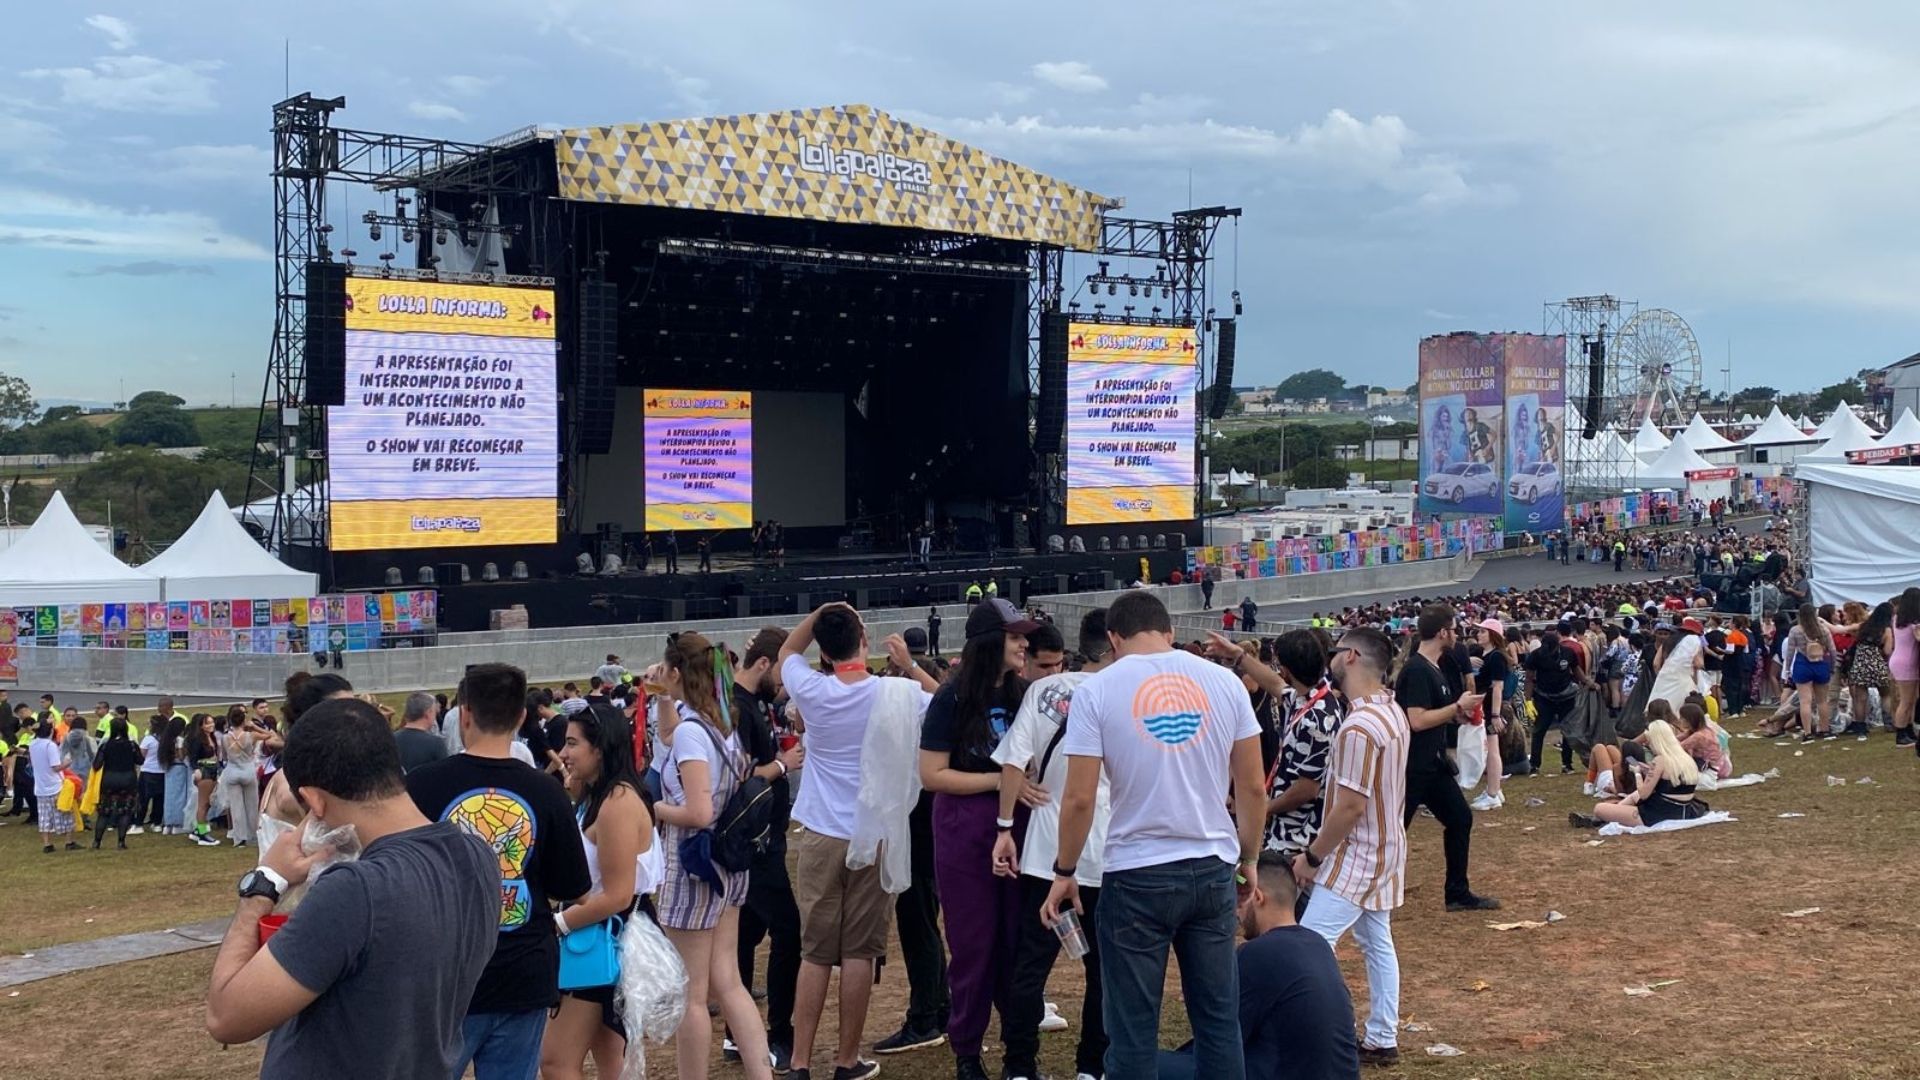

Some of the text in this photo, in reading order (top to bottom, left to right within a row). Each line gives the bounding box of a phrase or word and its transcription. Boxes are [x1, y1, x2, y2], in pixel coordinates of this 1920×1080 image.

[378, 295, 508, 318] LOLLA INFORMA:
[1096, 335, 1124, 347] LOLLA
[375, 355, 512, 373] A APRESENTAÇÃO FOI
[359, 373, 523, 391] INTERROMPIDA DEVIDO A
[1095, 380, 1171, 391] A APRESENTAÇÃO FOI
[363, 393, 525, 409] UM ACONTECIMENTO NÃO
[1086, 394, 1178, 405] INTERROMPIDA DEVIDO A
[405, 412, 485, 426] PLANEJADO.
[1088, 408, 1178, 419] UM ACONTECIMENTO NÃO
[1111, 422, 1156, 432] PLANEJADO.
[366, 439, 523, 455] O SHOW VAI RECOMEÇAR
[1089, 442, 1177, 452] O SHOW VAI RECOMEÇAR
[1863, 448, 1895, 459] BEBIDAS
[412, 458, 480, 472] EM BREVE.
[1114, 456, 1152, 466] EM BREVE.
